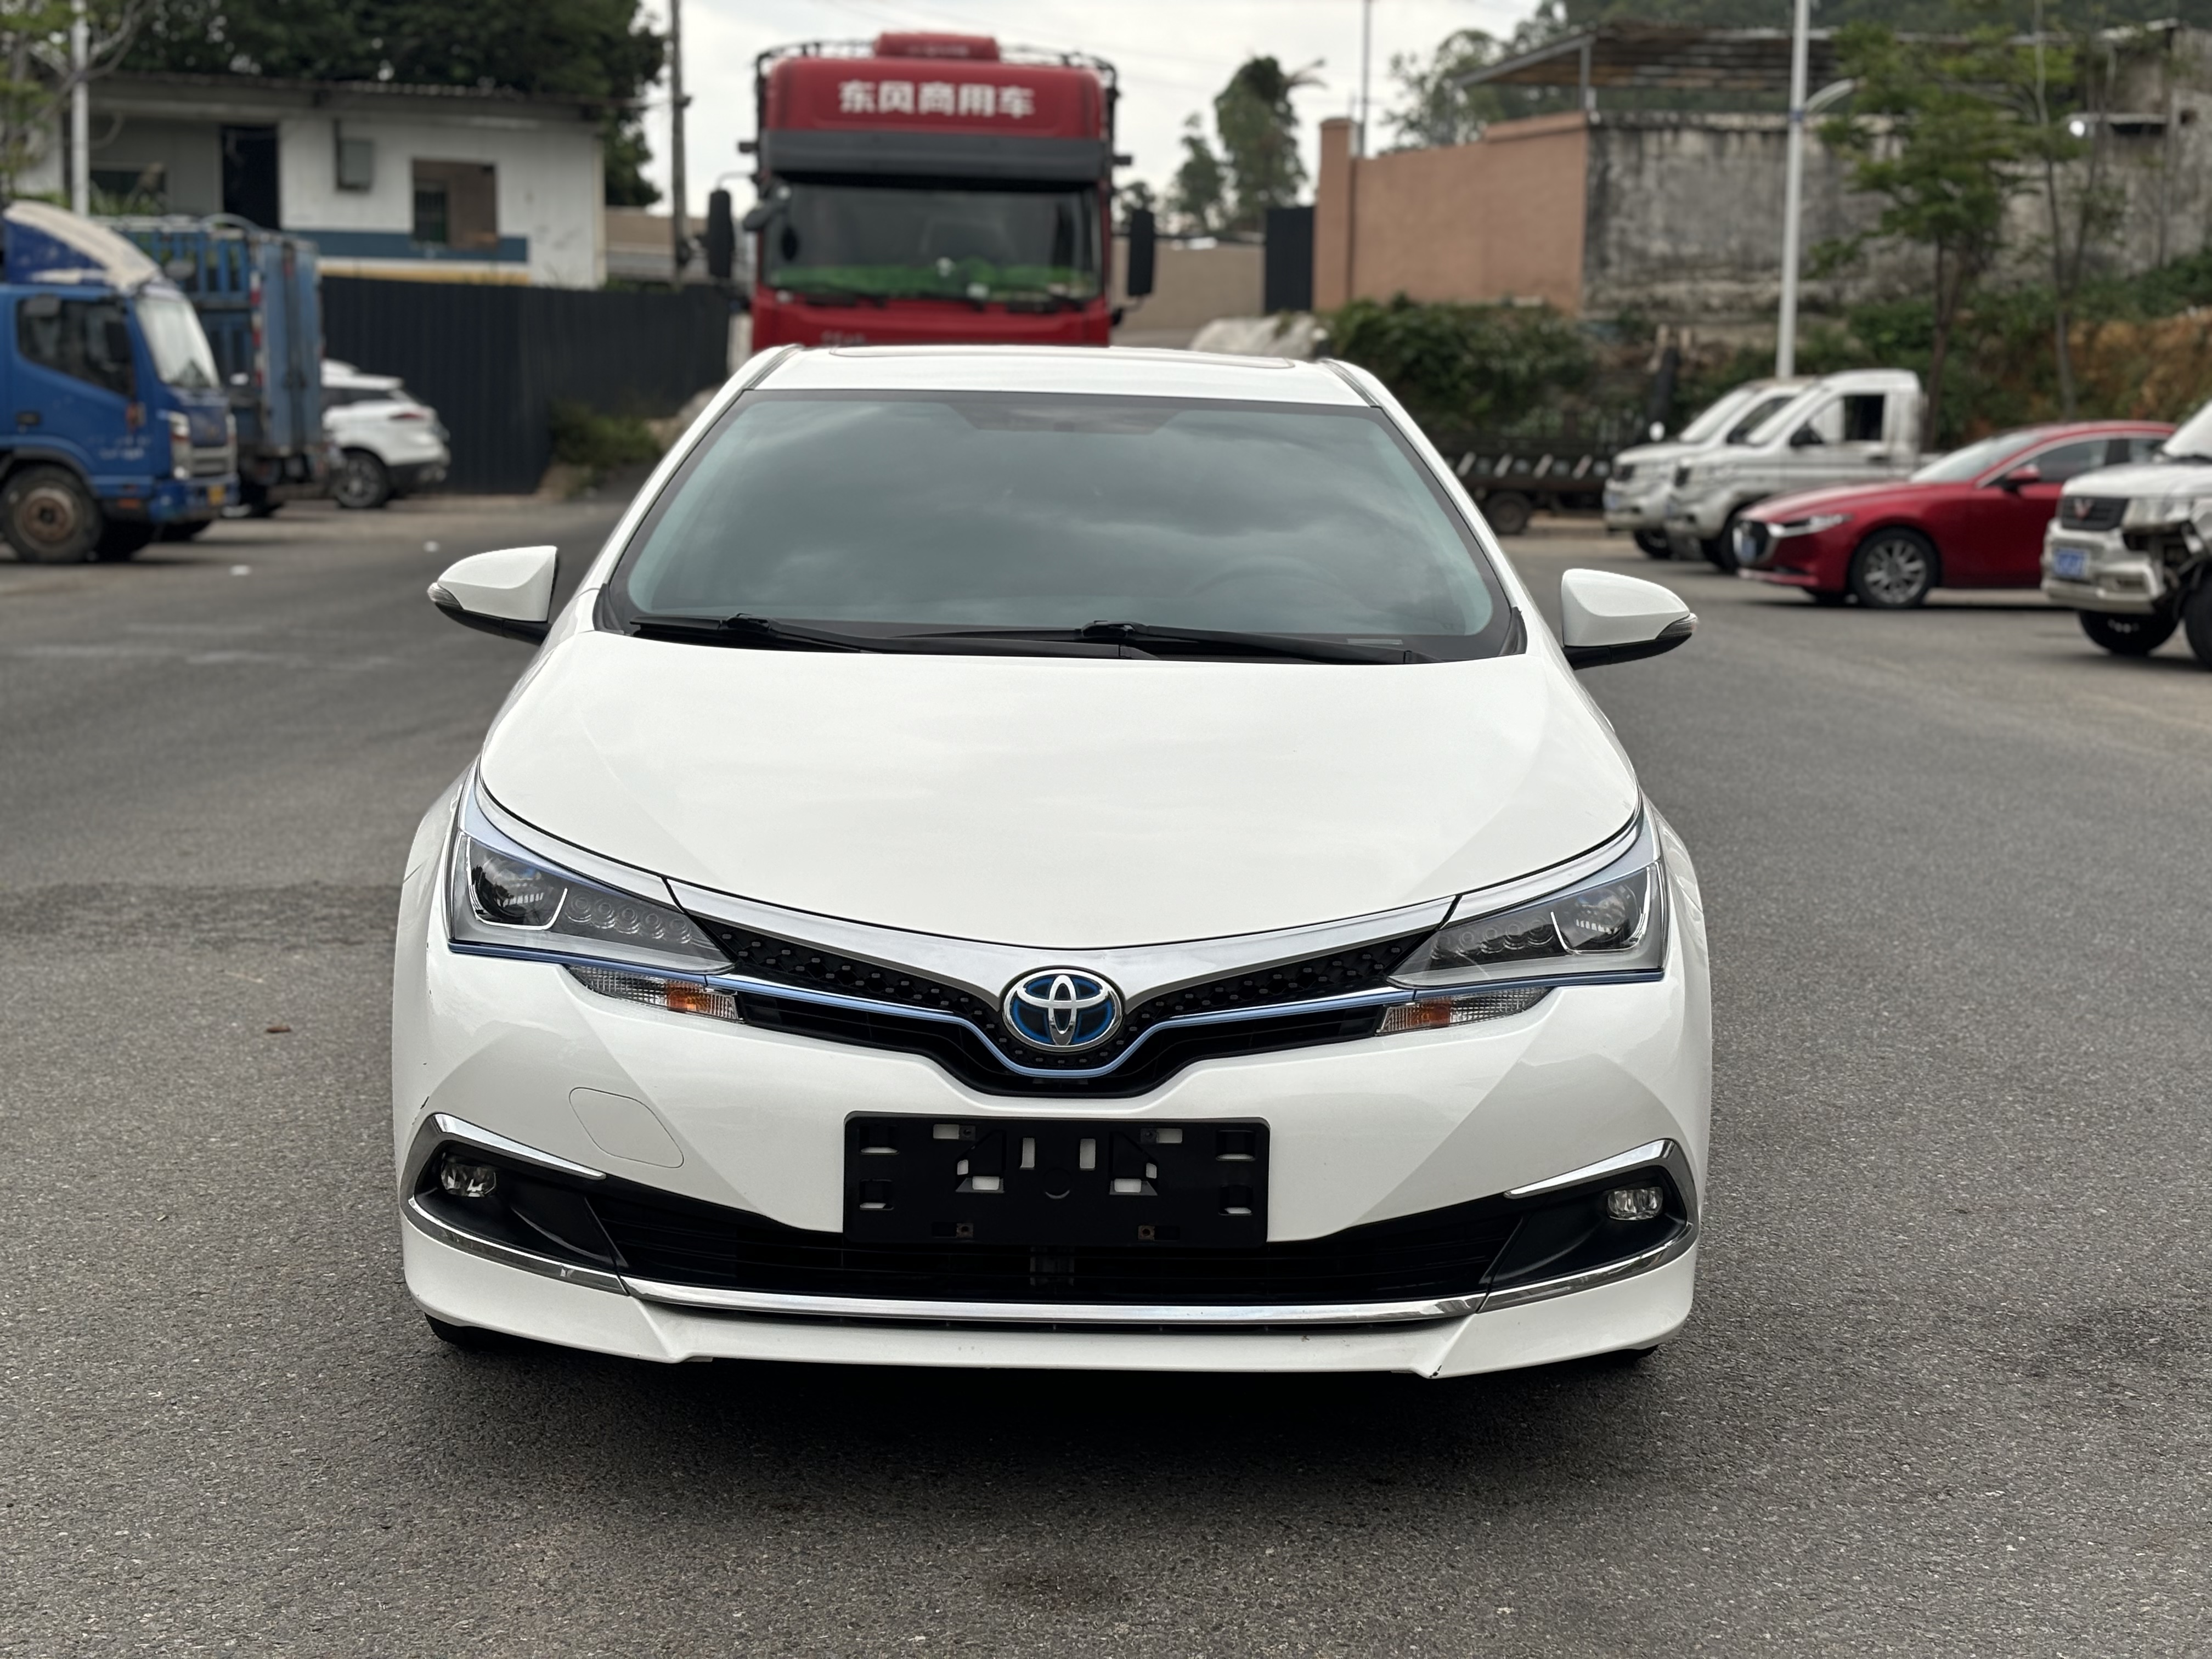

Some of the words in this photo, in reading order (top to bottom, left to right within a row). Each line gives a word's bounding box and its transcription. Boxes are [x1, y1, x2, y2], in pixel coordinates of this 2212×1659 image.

[838, 80, 1035, 119] 东风商用车
